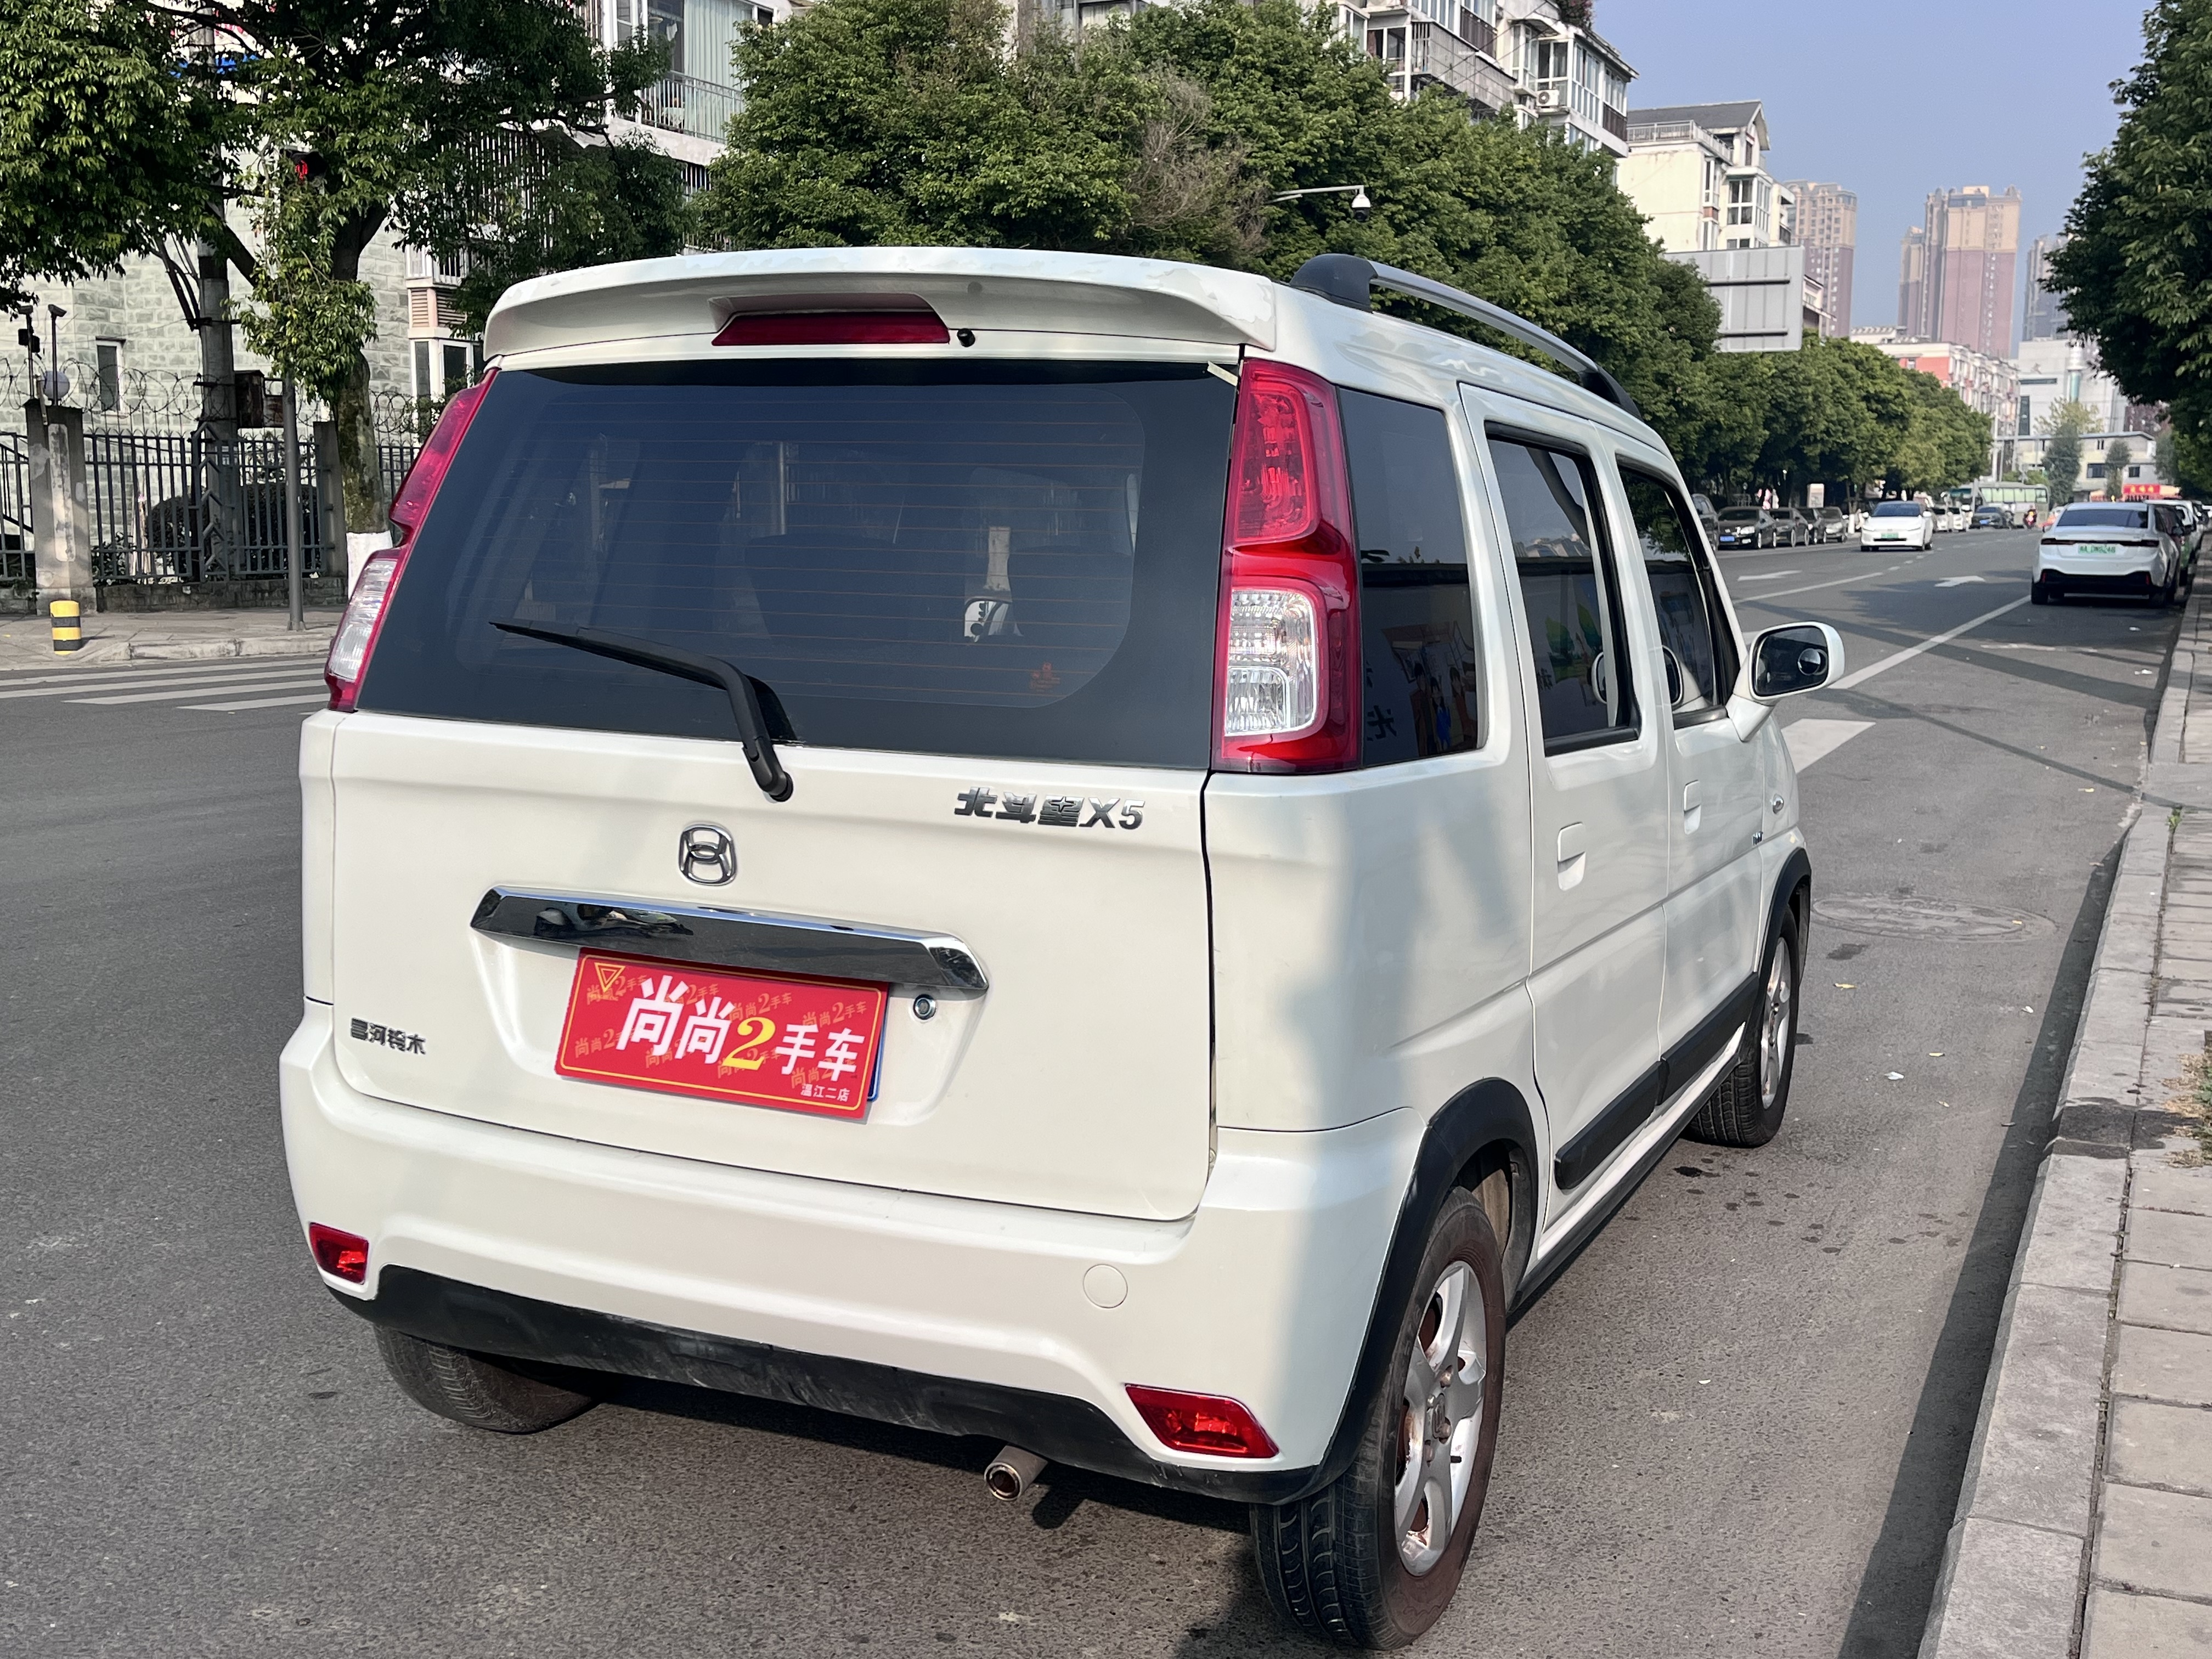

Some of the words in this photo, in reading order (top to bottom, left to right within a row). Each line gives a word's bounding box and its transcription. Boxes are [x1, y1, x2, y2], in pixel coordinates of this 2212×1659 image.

[954, 786, 1146, 830] 北斗星X5
[616, 974, 865, 1081] 尚尚2手车
[800, 1084, 850, 1102] 温江二店
